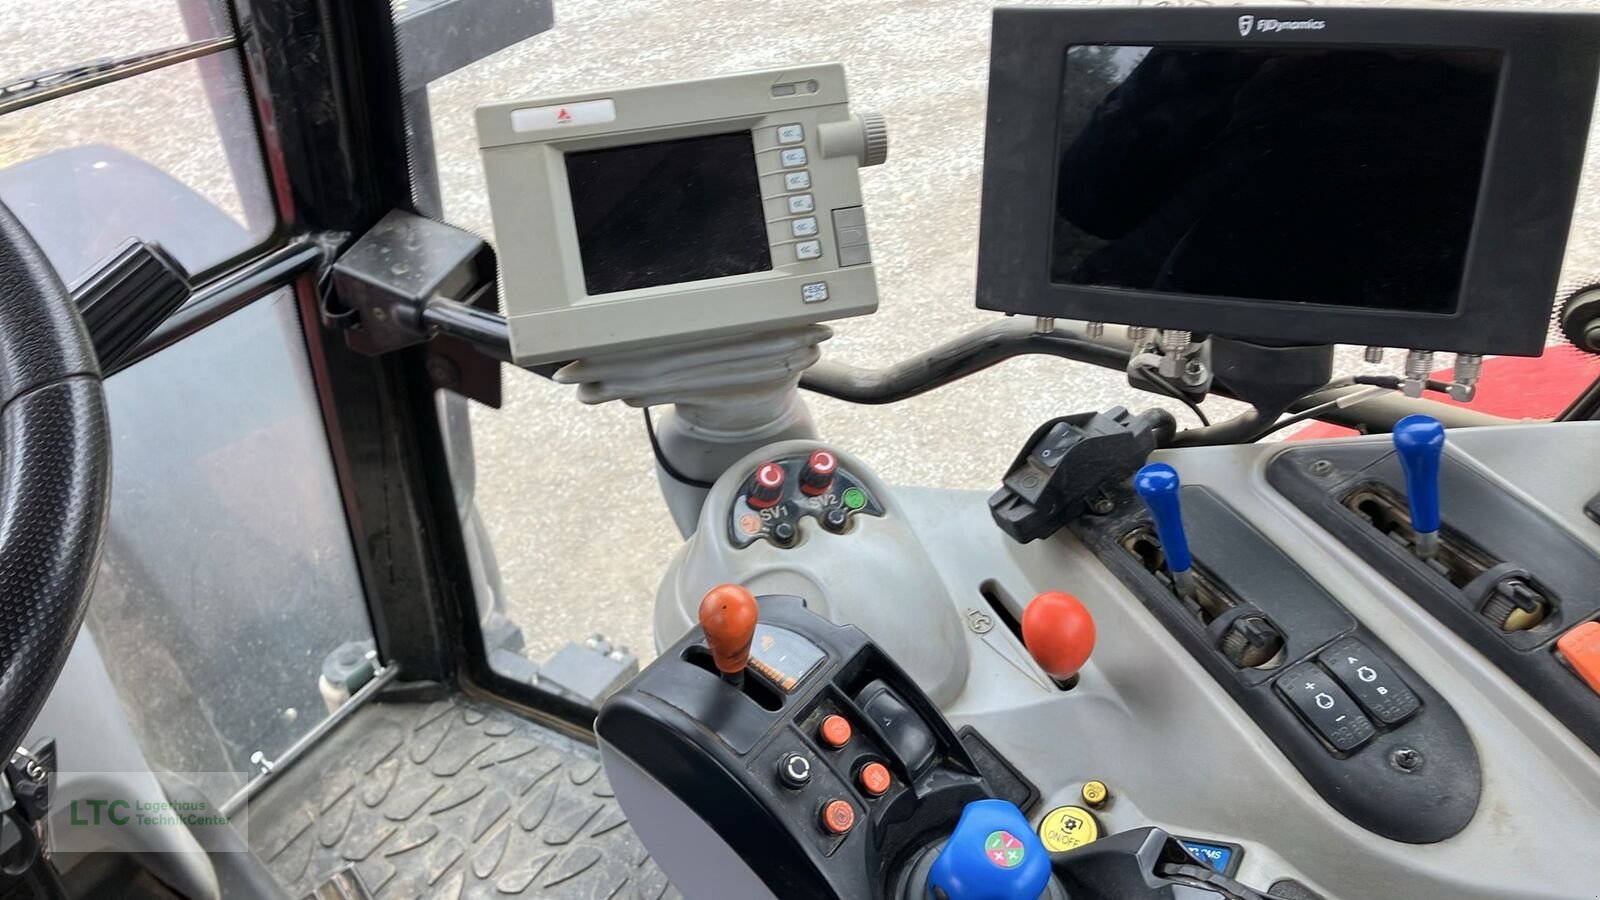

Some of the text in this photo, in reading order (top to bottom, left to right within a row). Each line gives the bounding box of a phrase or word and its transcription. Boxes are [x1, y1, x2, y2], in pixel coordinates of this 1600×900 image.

[808, 493, 839, 510] SV2
[759, 505, 789, 521] SV1
[1347, 656, 1359, 665] A
[1376, 685, 1389, 696] B
[1048, 830, 1081, 848] ON/OFF
